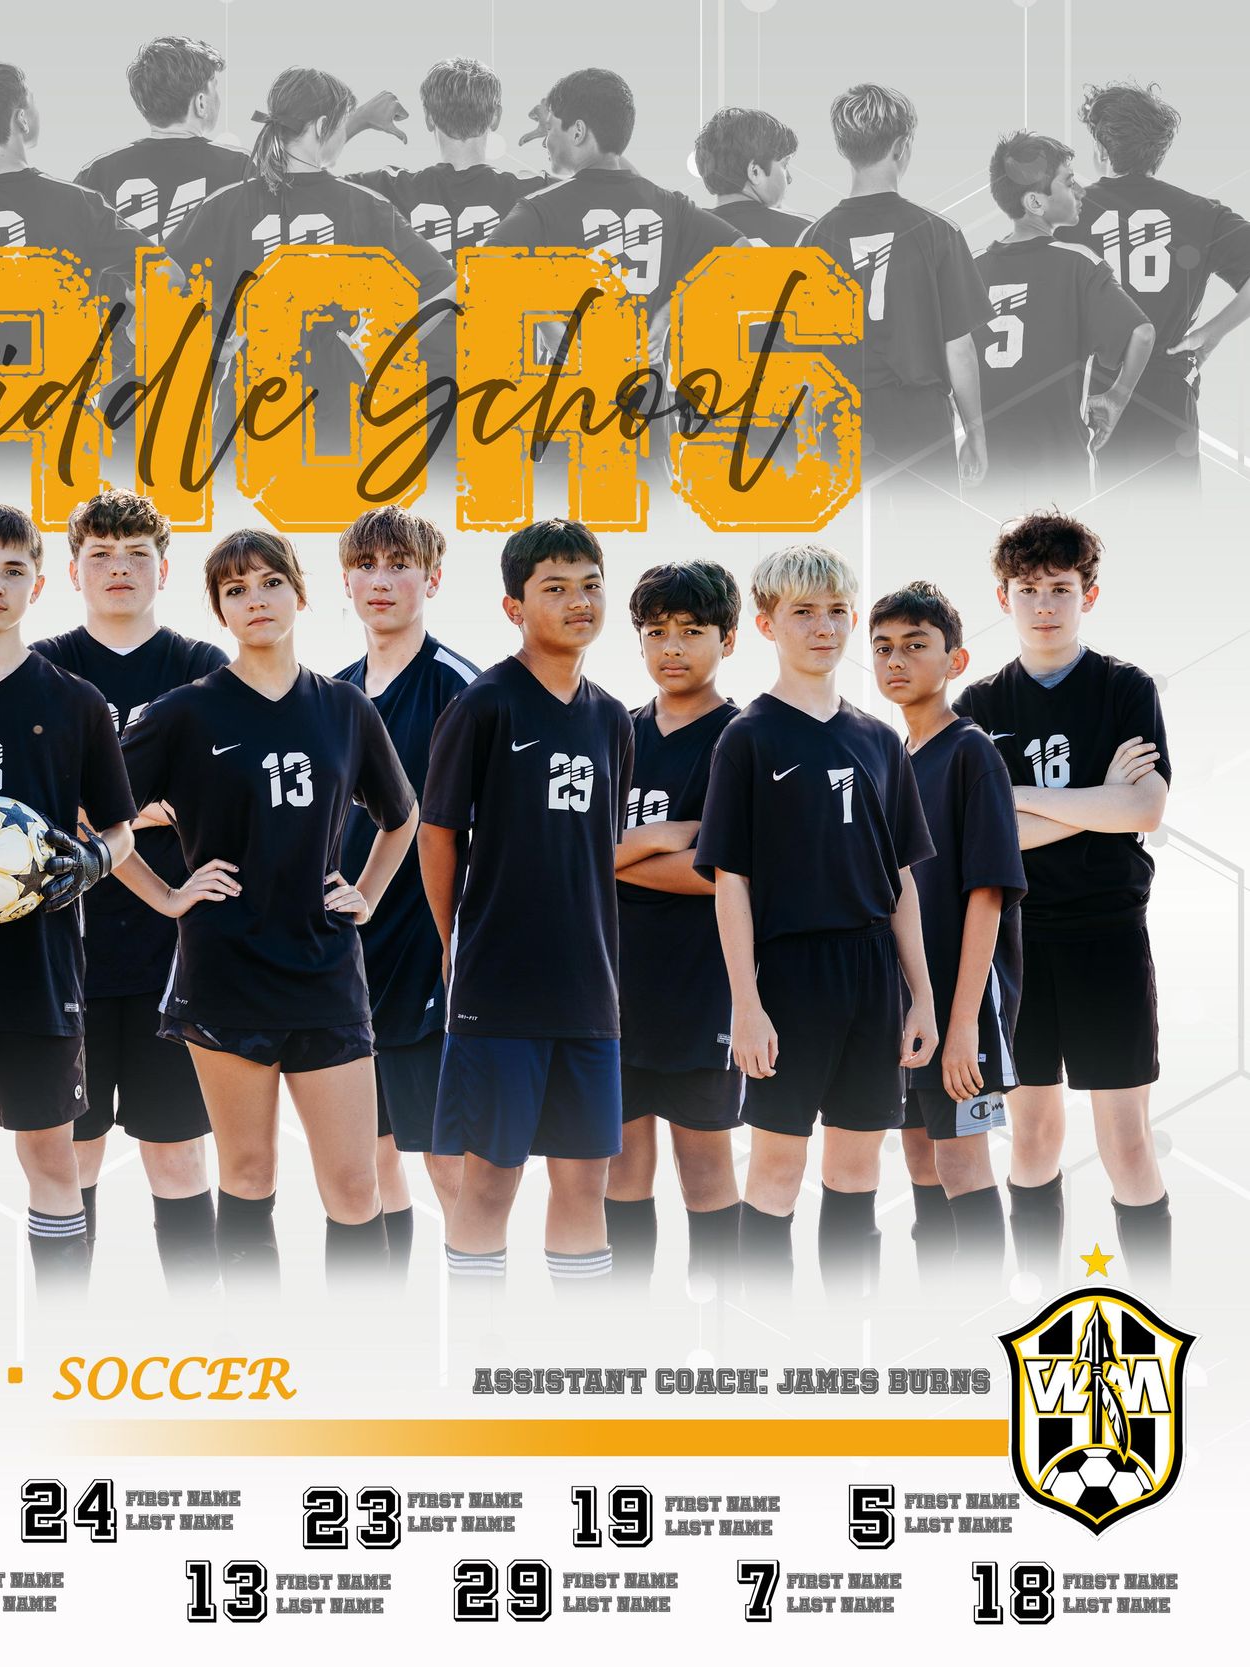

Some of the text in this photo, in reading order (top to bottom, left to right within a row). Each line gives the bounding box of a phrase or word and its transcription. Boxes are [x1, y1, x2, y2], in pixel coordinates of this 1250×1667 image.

[582, 208, 662, 294] 29
[849, 232, 895, 321] 7
[1091, 209, 1172, 292] 18
[984, 283, 1028, 369] 5
[261, 752, 313, 807] 13
[548, 753, 594, 812] 29
[831, 767, 854, 823] 7
[1023, 734, 1070, 788] 18
